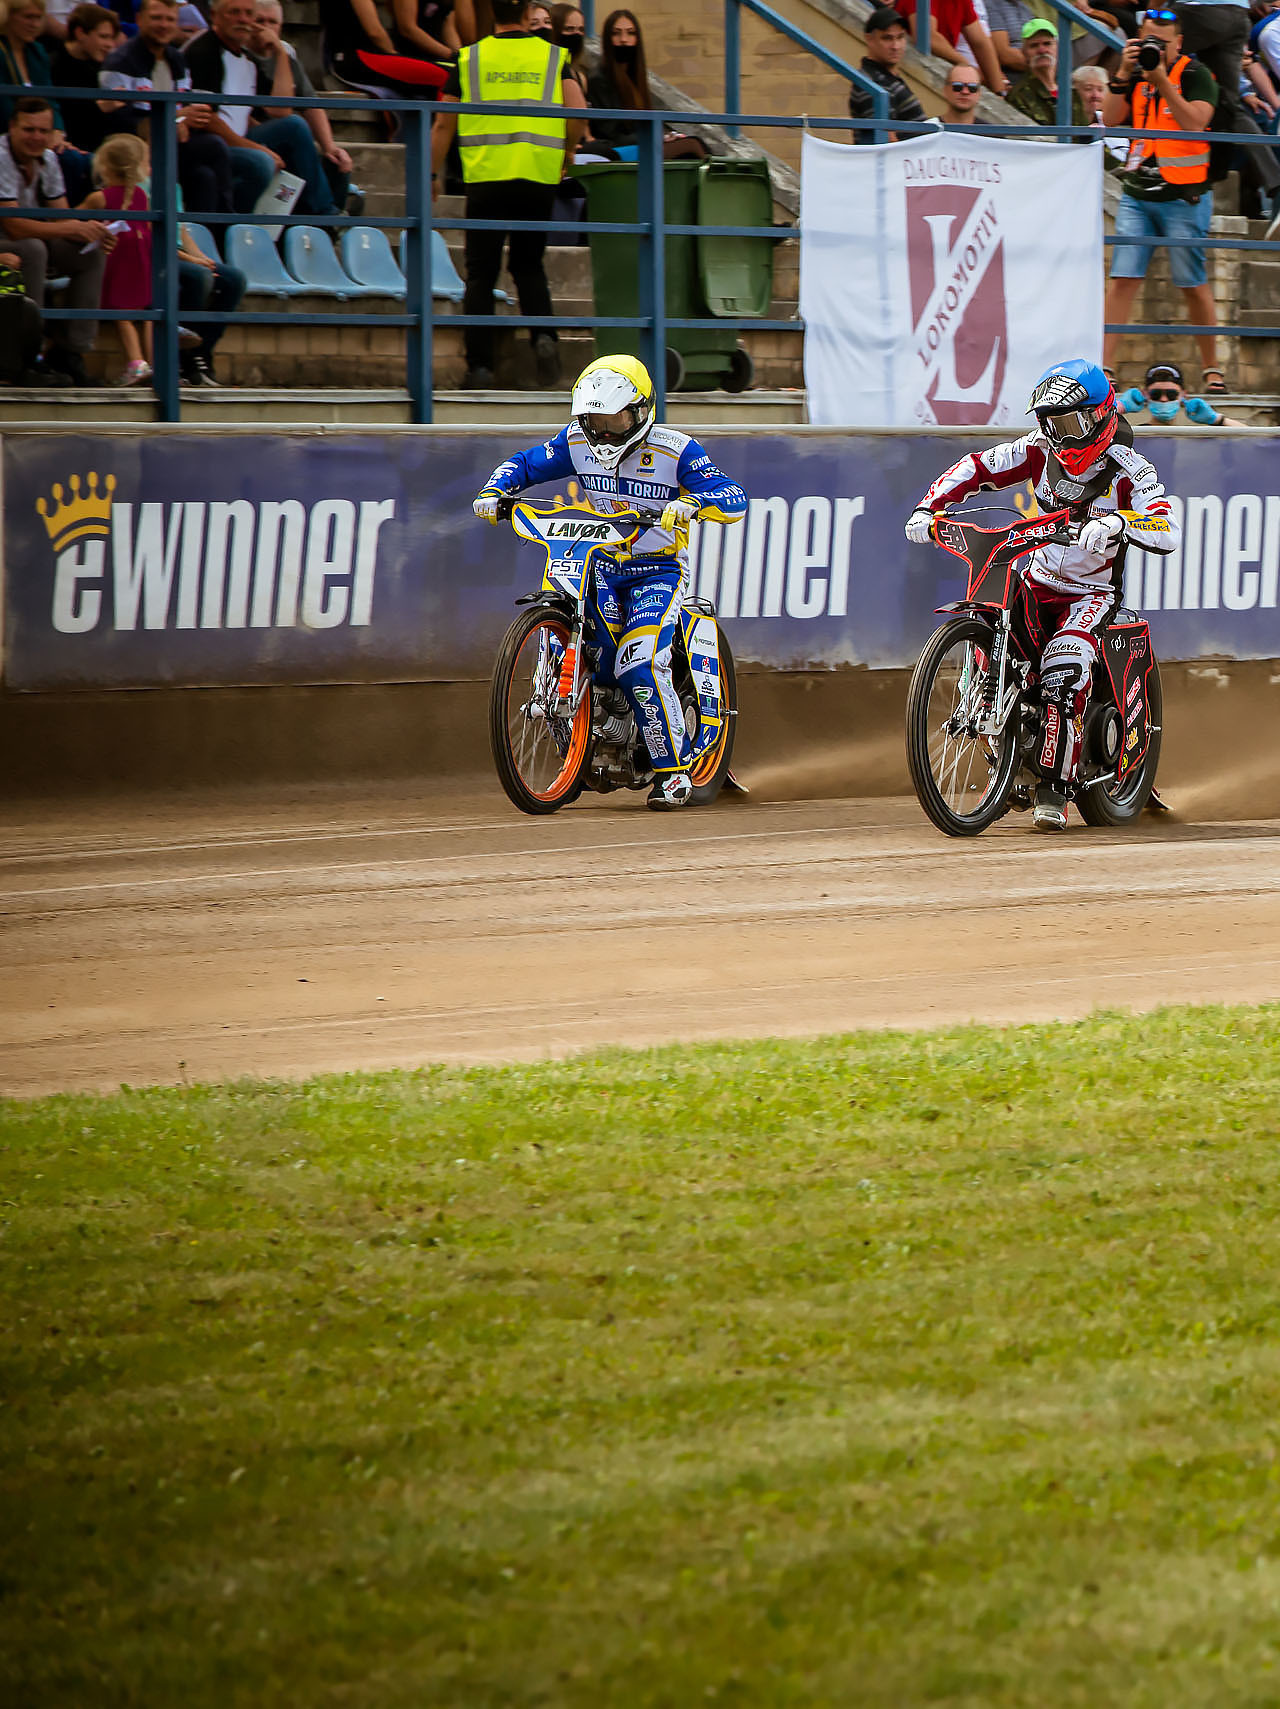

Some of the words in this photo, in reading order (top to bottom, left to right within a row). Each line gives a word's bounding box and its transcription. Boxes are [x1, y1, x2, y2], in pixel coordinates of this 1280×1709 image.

[903, 156, 1001, 183] DAUGAVPILS
[917, 200, 999, 367] LOKOMOTIV
[626, 480, 671, 499] TORUN
[546, 522, 611, 540] LAVOR
[52, 499, 396, 634] ewinner
[550, 560, 582, 574] FST
[992, 632, 1001, 661] FALCON
[1043, 641, 1082, 656] Interio
[1042, 703, 1059, 766] PRINTSOL
